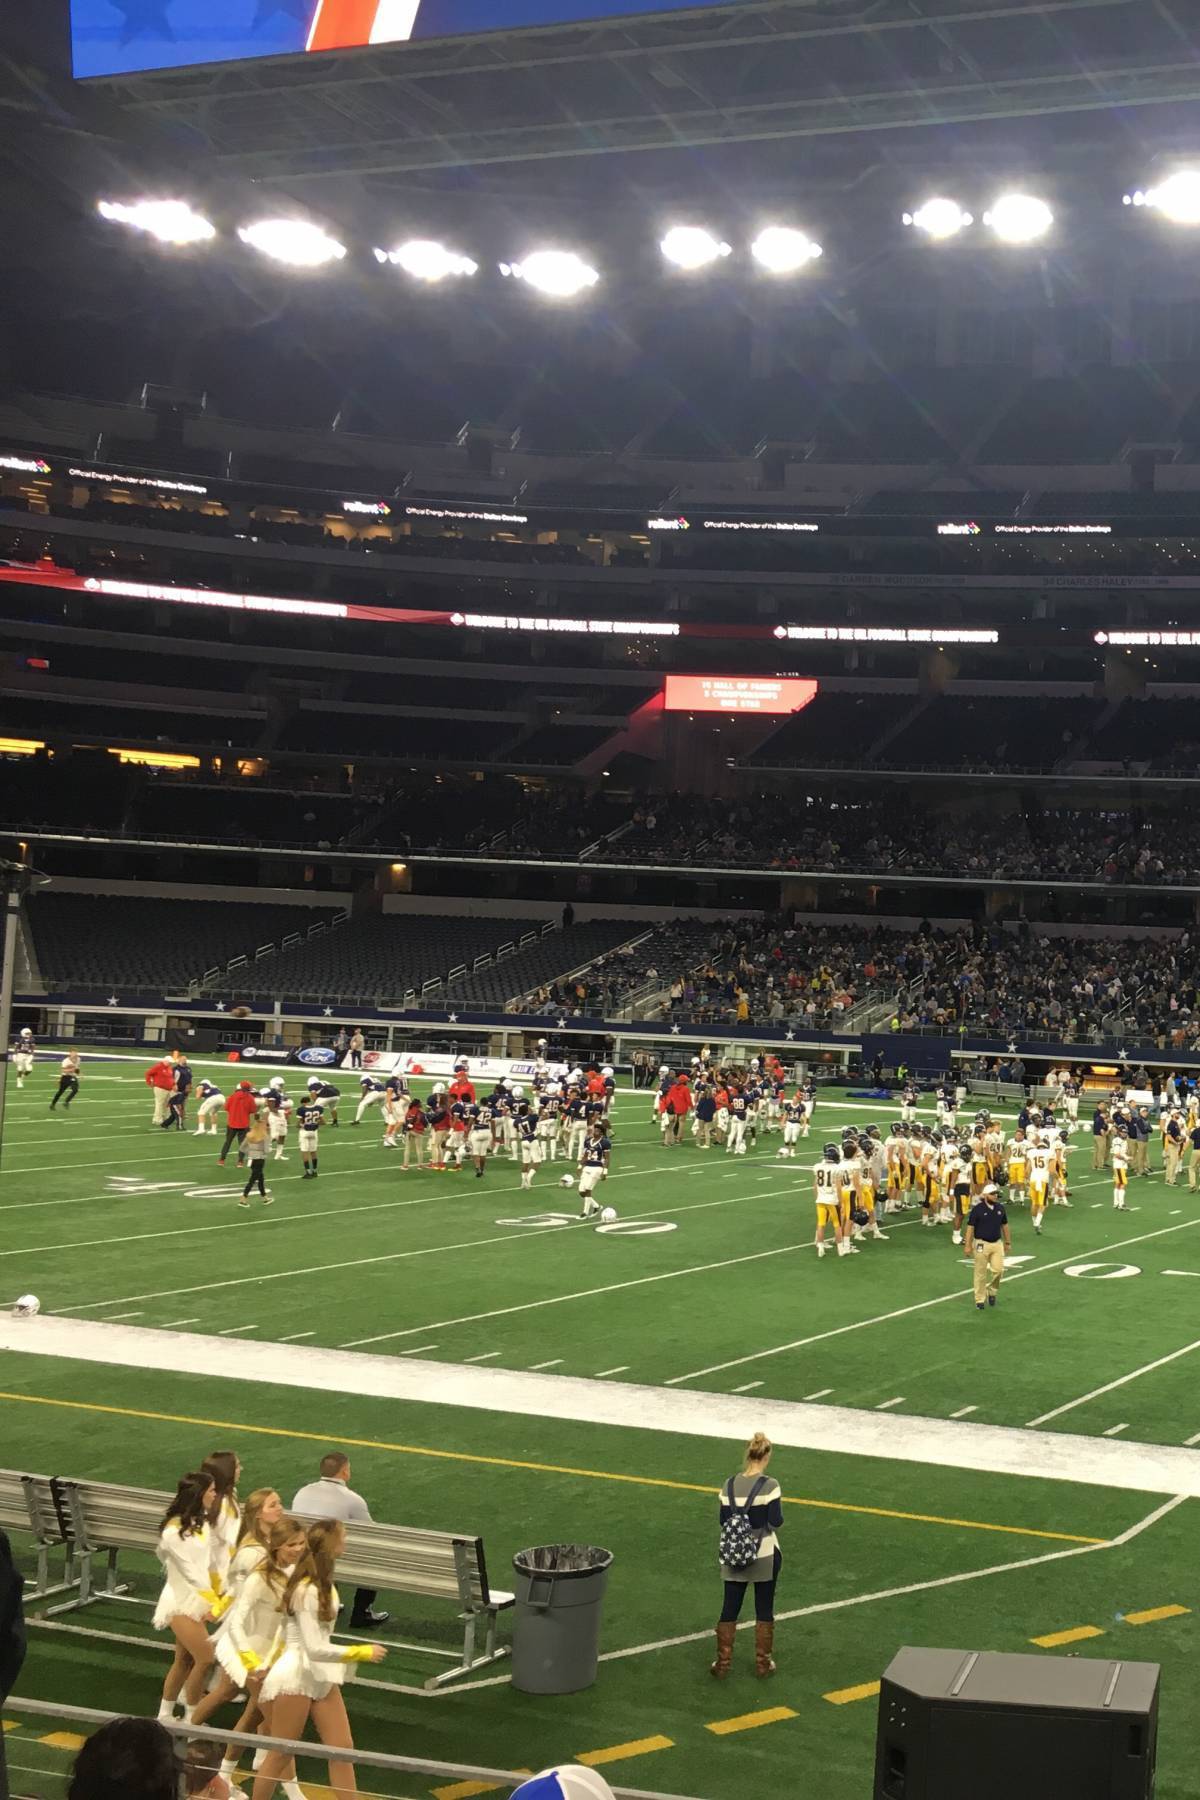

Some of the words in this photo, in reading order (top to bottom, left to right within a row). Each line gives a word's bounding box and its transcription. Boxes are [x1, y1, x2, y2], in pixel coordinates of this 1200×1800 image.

[304, 1050, 329, 1062] Ford
[732, 1098, 745, 1110] 88
[304, 1111, 320, 1124] 22
[478, 1112, 492, 1125] 42
[578, 1107, 586, 1118] 4
[1033, 1155, 1045, 1169] 15
[817, 1169, 832, 1188] 81
